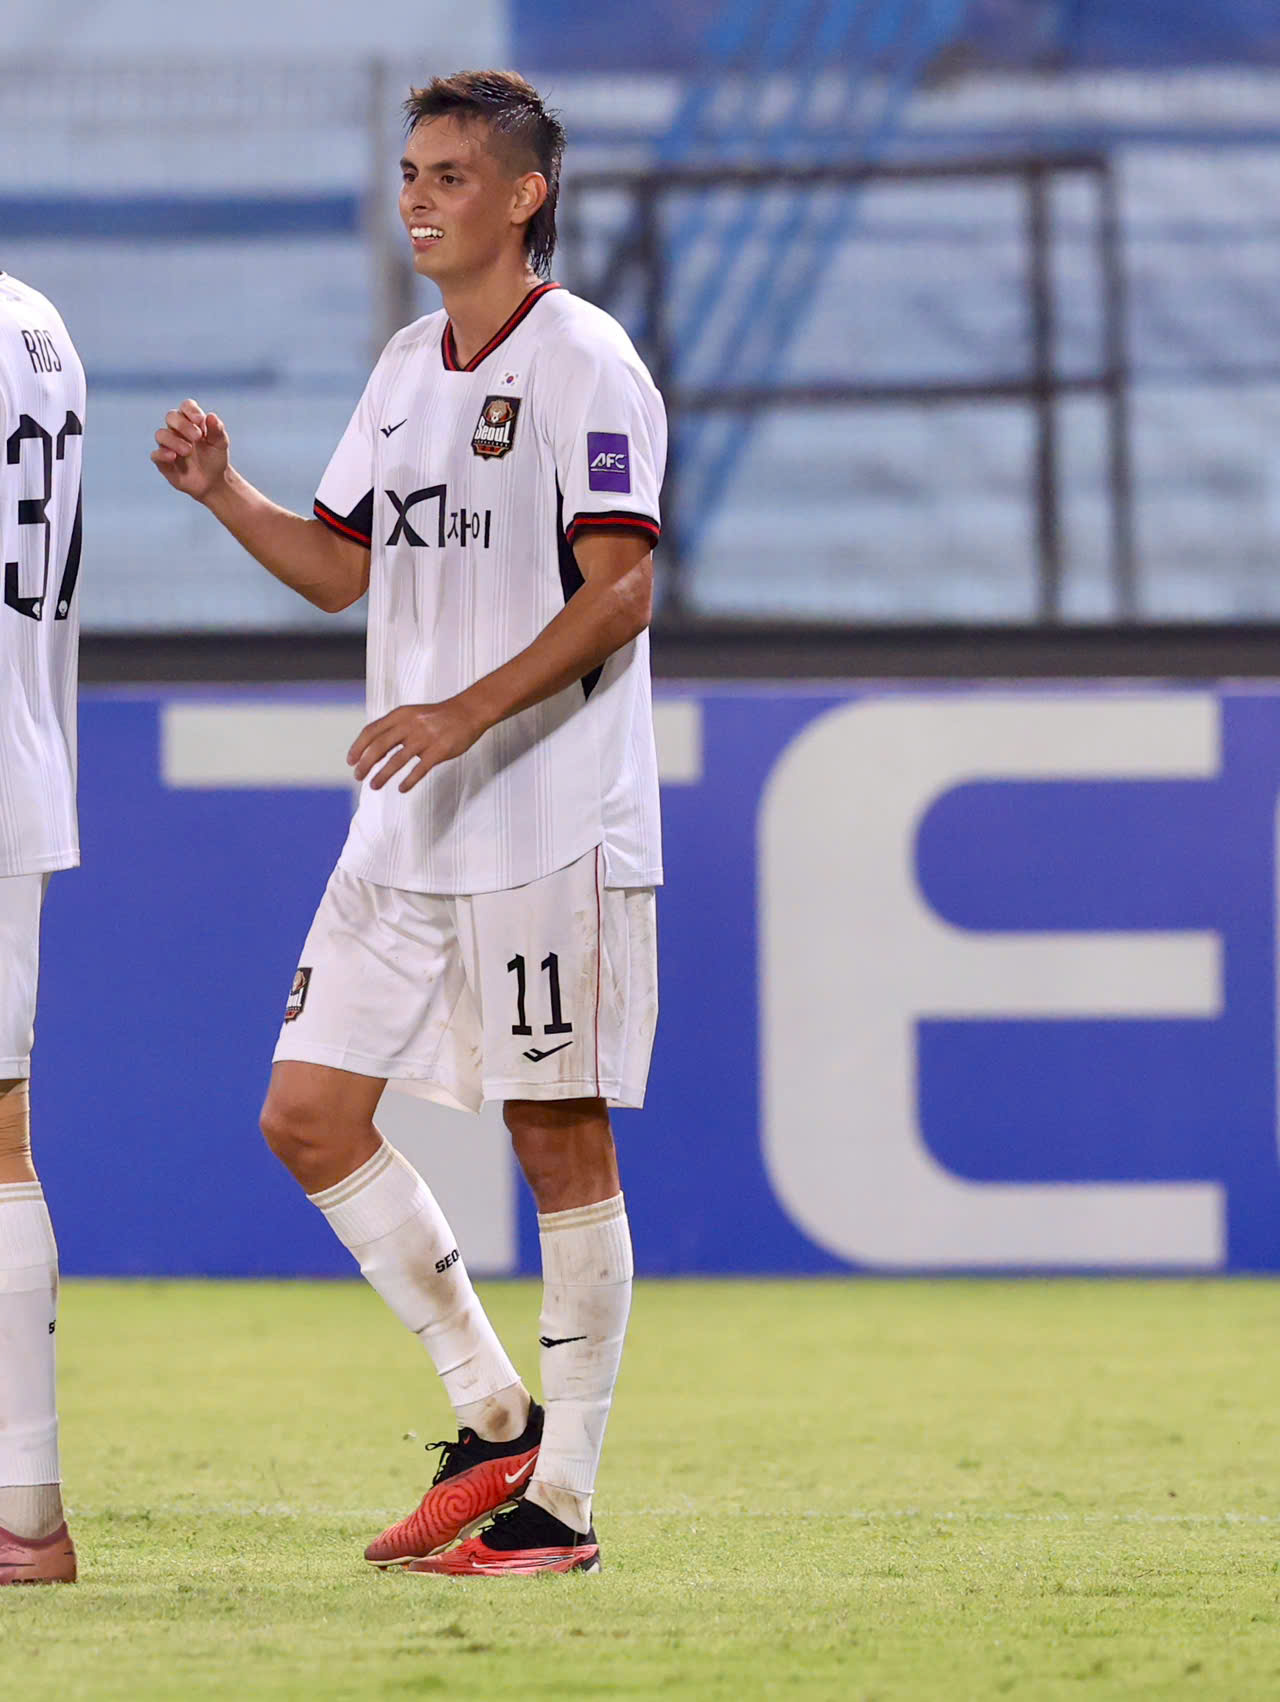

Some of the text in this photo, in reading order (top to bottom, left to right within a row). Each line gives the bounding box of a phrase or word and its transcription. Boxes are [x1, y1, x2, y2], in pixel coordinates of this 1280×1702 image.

[21, 329, 62, 374] ROS
[590, 452, 626, 469] AFC
[4, 410, 83, 621] 37
[507, 952, 573, 1036] 11
[435, 1248, 460, 1273] SEO
